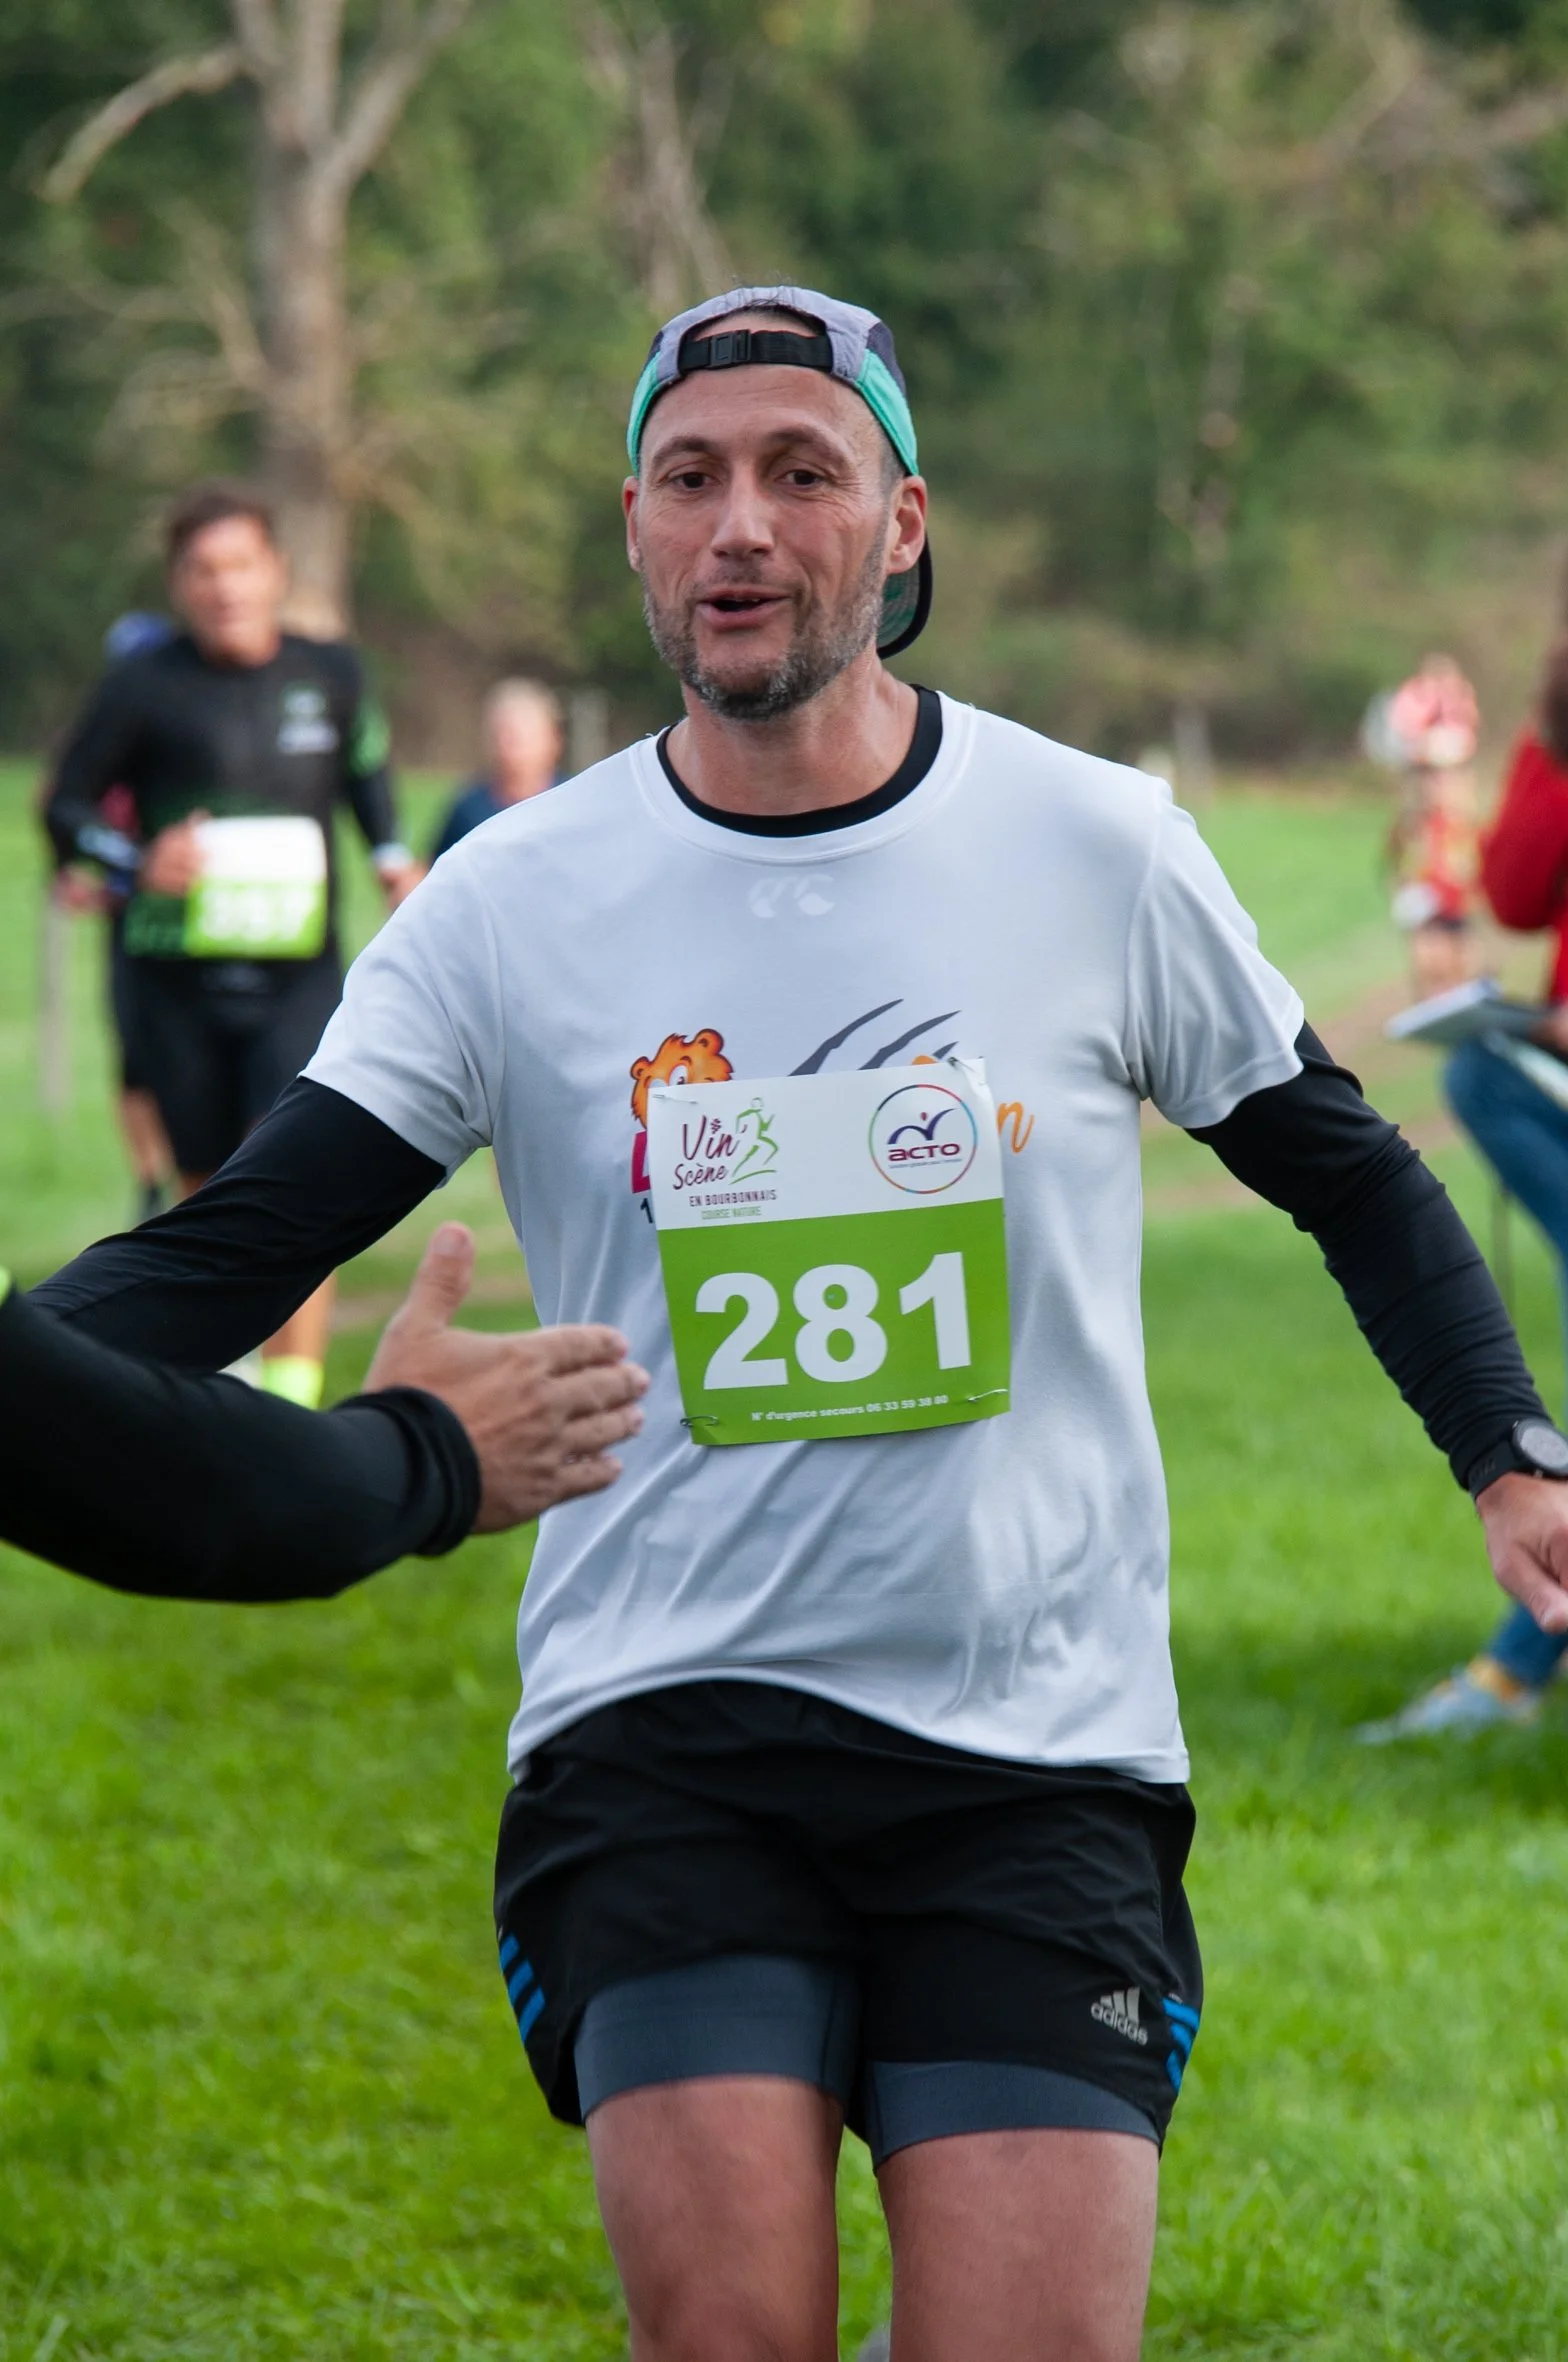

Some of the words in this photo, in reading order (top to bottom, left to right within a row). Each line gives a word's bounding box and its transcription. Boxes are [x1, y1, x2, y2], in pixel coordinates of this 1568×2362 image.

[673, 1162, 728, 1190] Scène
[689, 1195, 702, 1207] EN
[705, 1189, 777, 1206] BOURBONNAIS
[695, 1251, 972, 1391] 281
[819, 1405, 865, 1417] secours
[883, 1401, 899, 1411] 33
[1090, 2002, 1148, 2046] adidas
